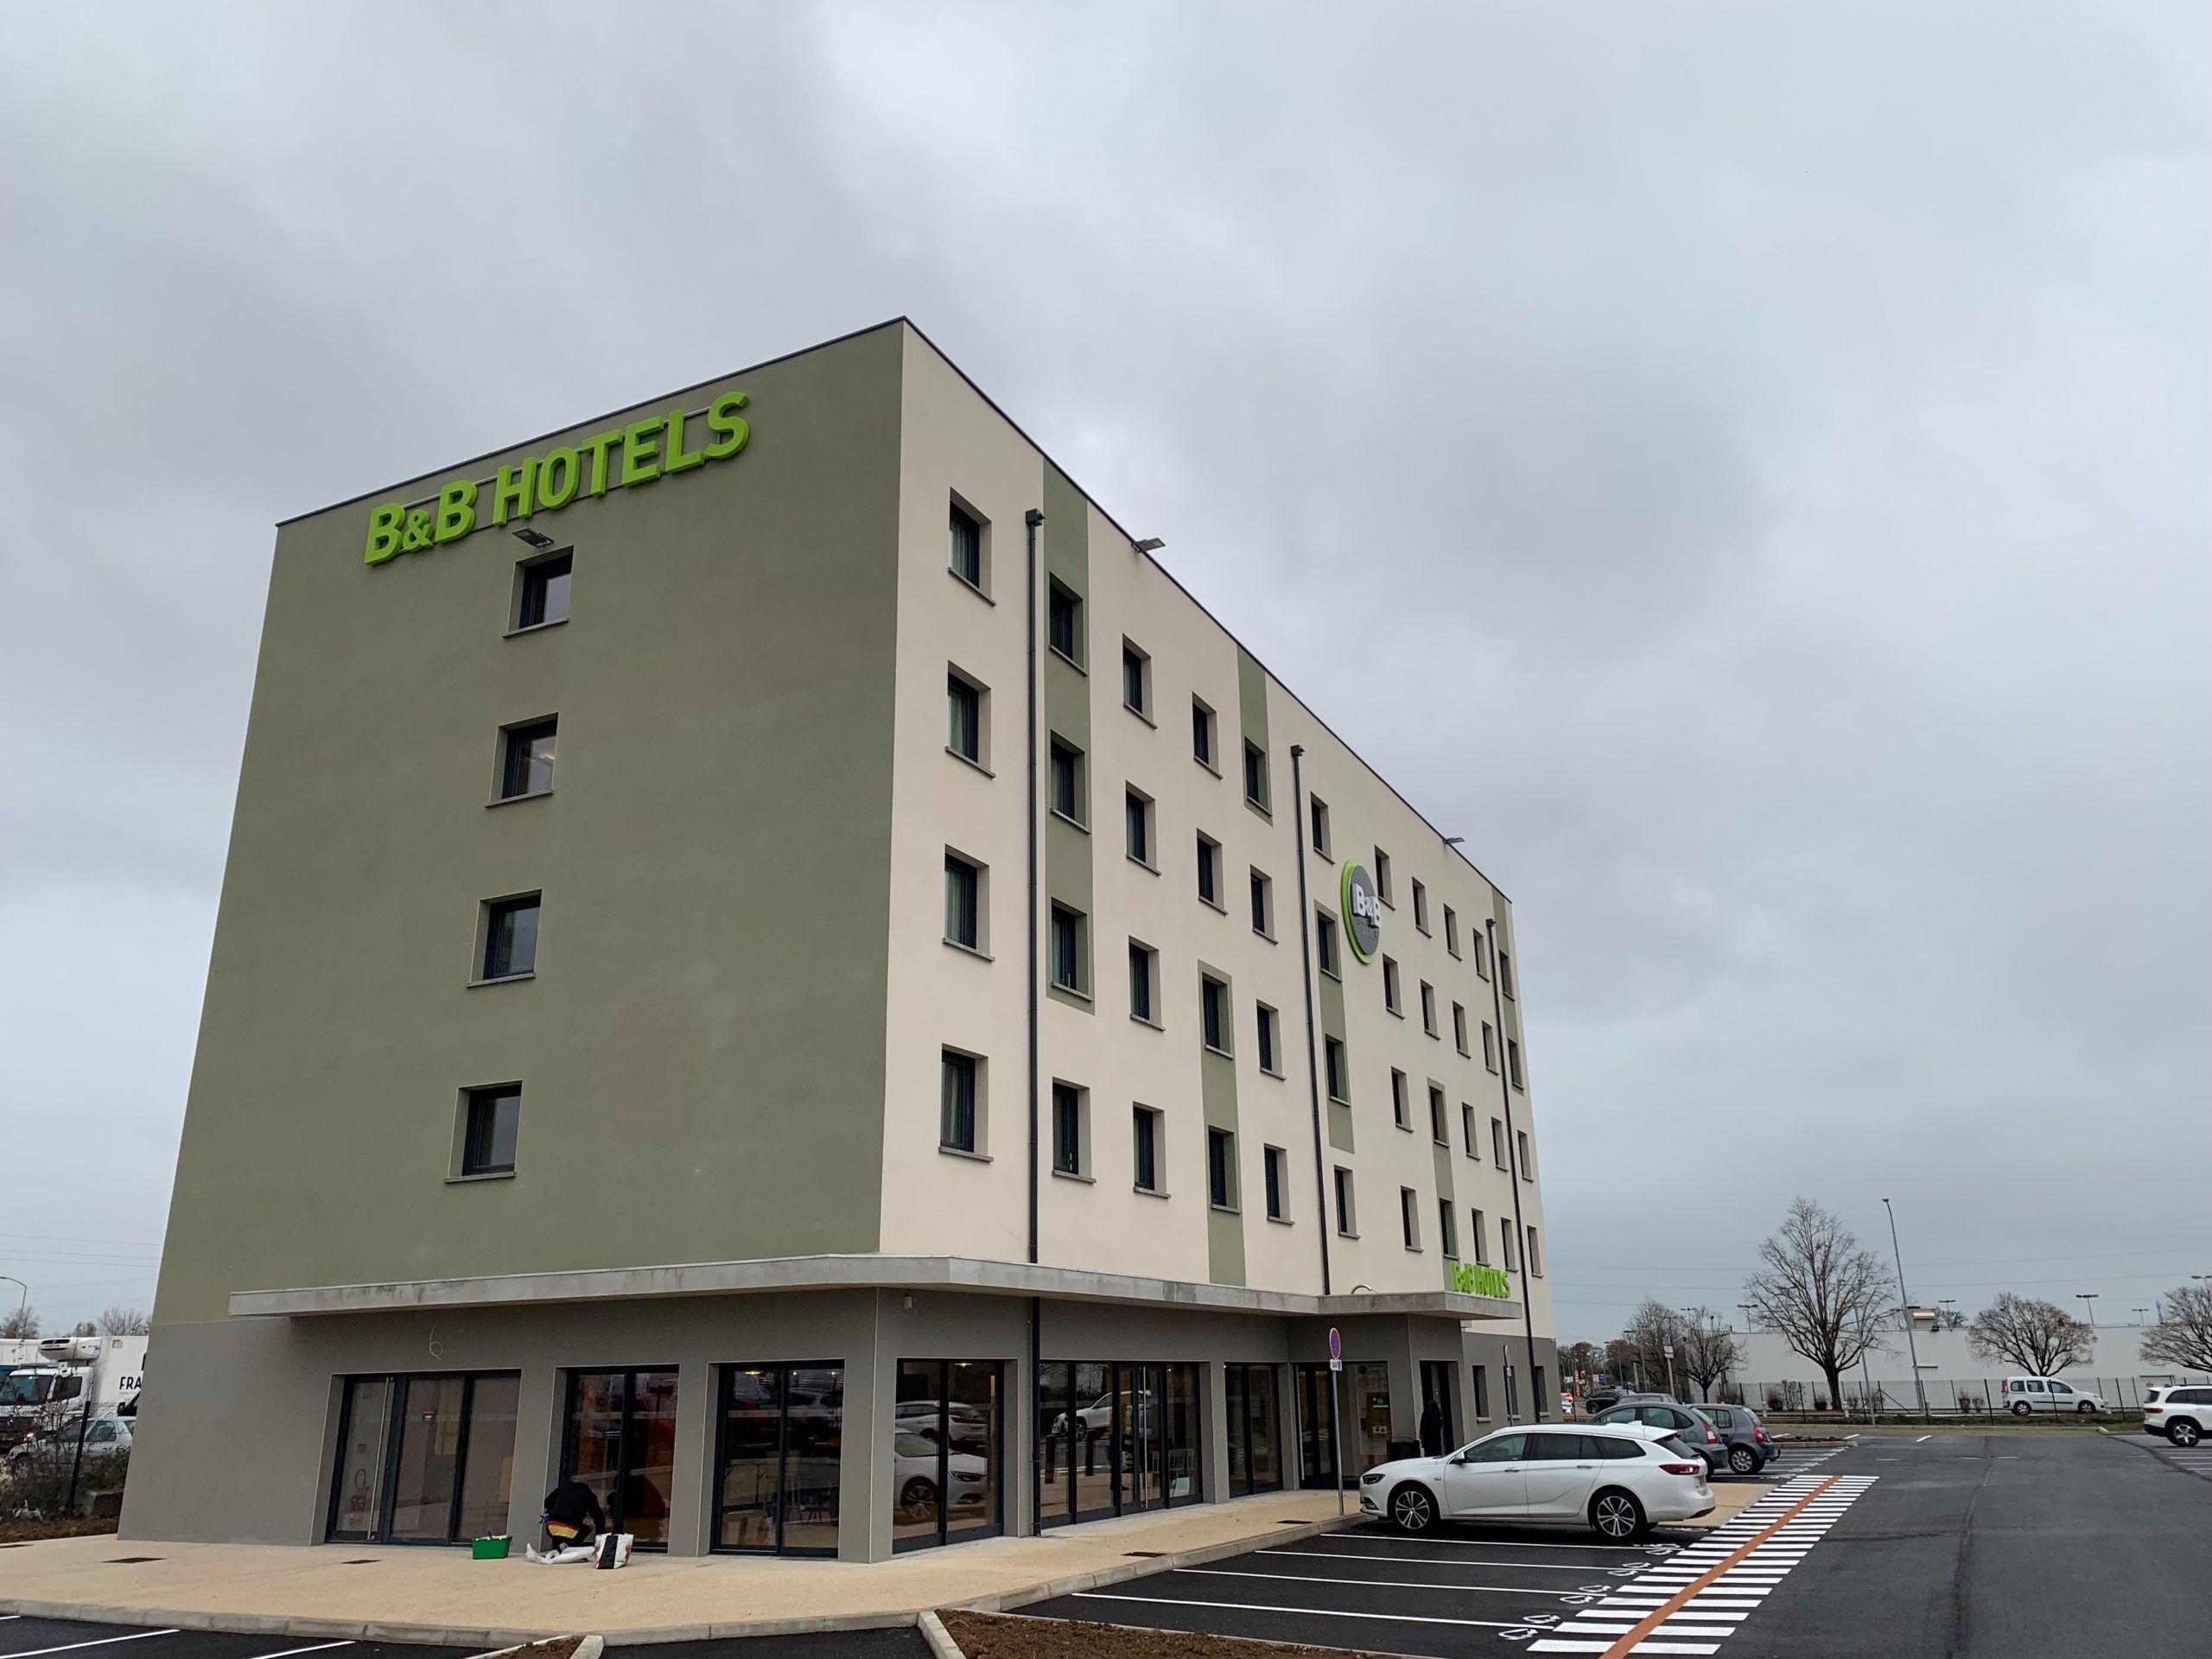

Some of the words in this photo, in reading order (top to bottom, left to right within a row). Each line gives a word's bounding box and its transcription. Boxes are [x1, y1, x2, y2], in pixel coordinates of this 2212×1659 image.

[364, 479, 477, 565] B&B
[492, 391, 750, 526] HOTELS
[1351, 883, 1382, 928] B&B
